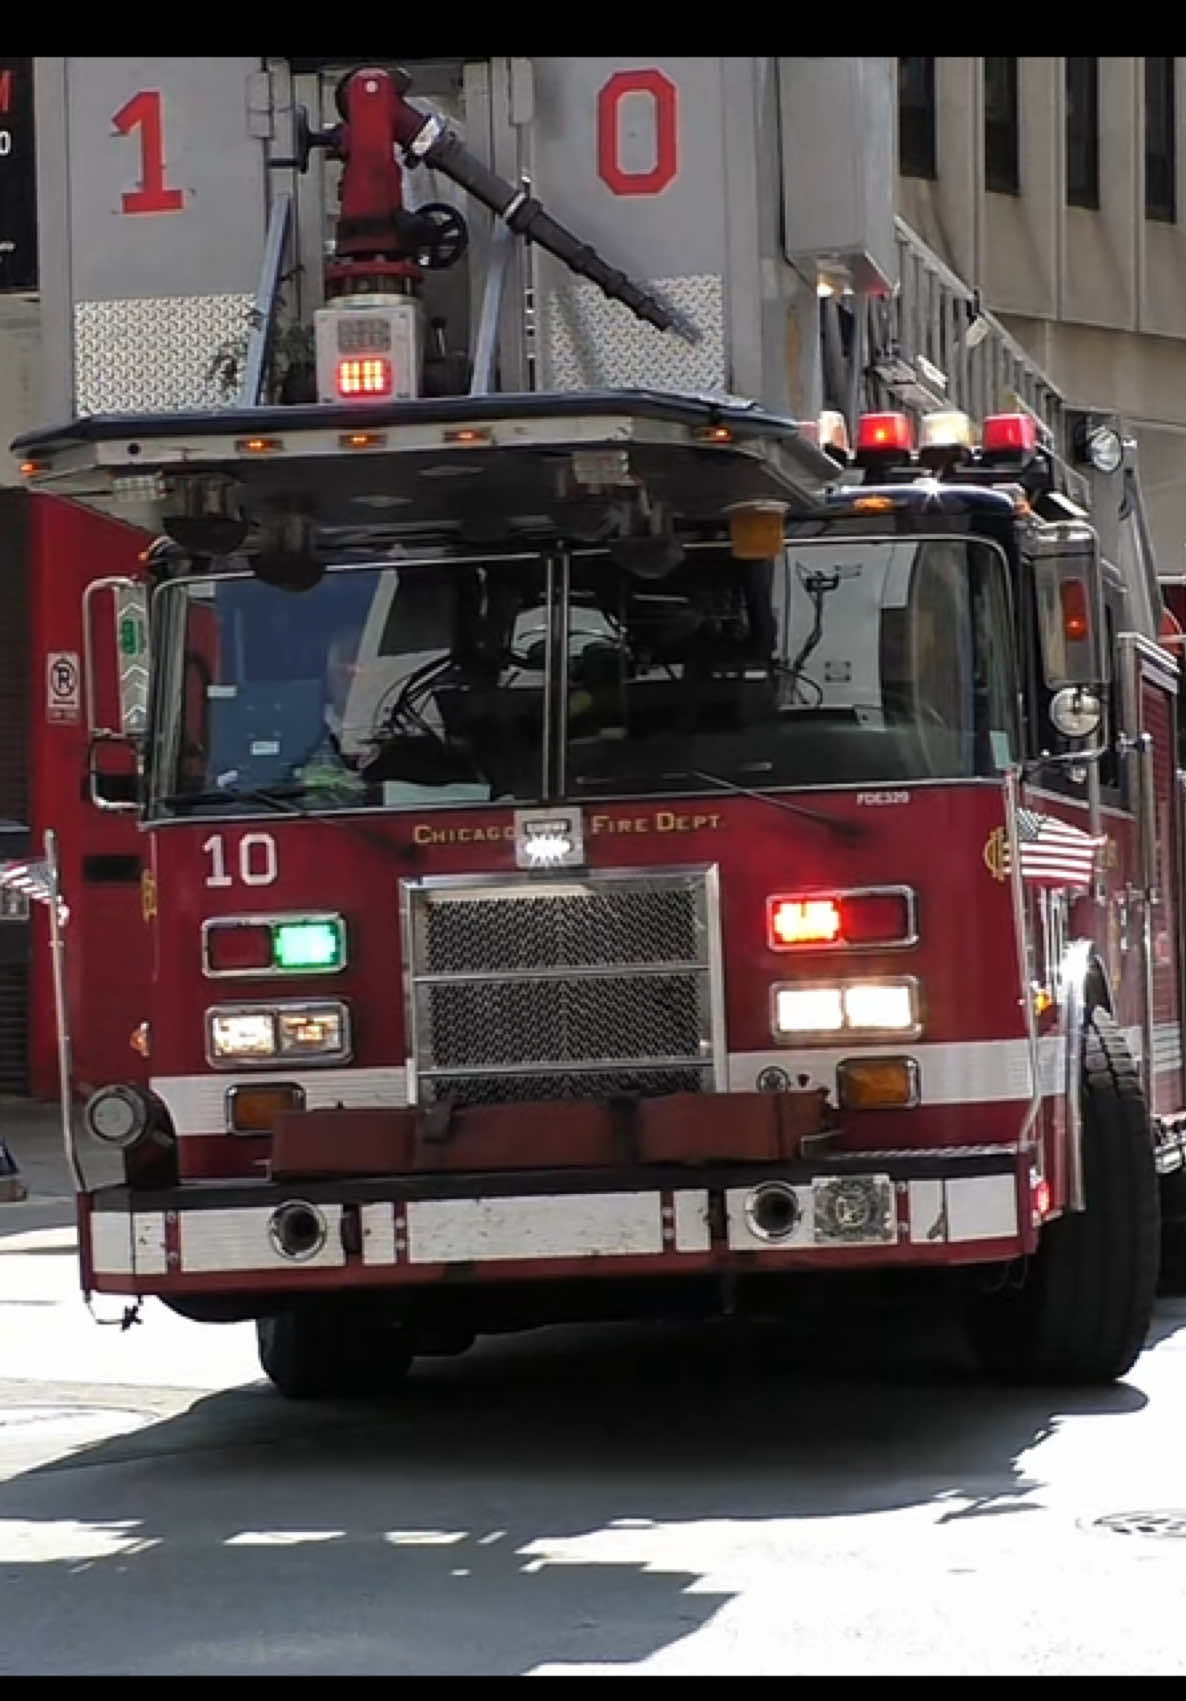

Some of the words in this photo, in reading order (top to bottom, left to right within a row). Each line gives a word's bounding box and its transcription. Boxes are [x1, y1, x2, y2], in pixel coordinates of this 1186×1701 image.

[111, 90, 185, 215] 1
[597, 69, 678, 196] 0
[590, 815, 649, 833] FIRE
[203, 833, 277, 887] 10
